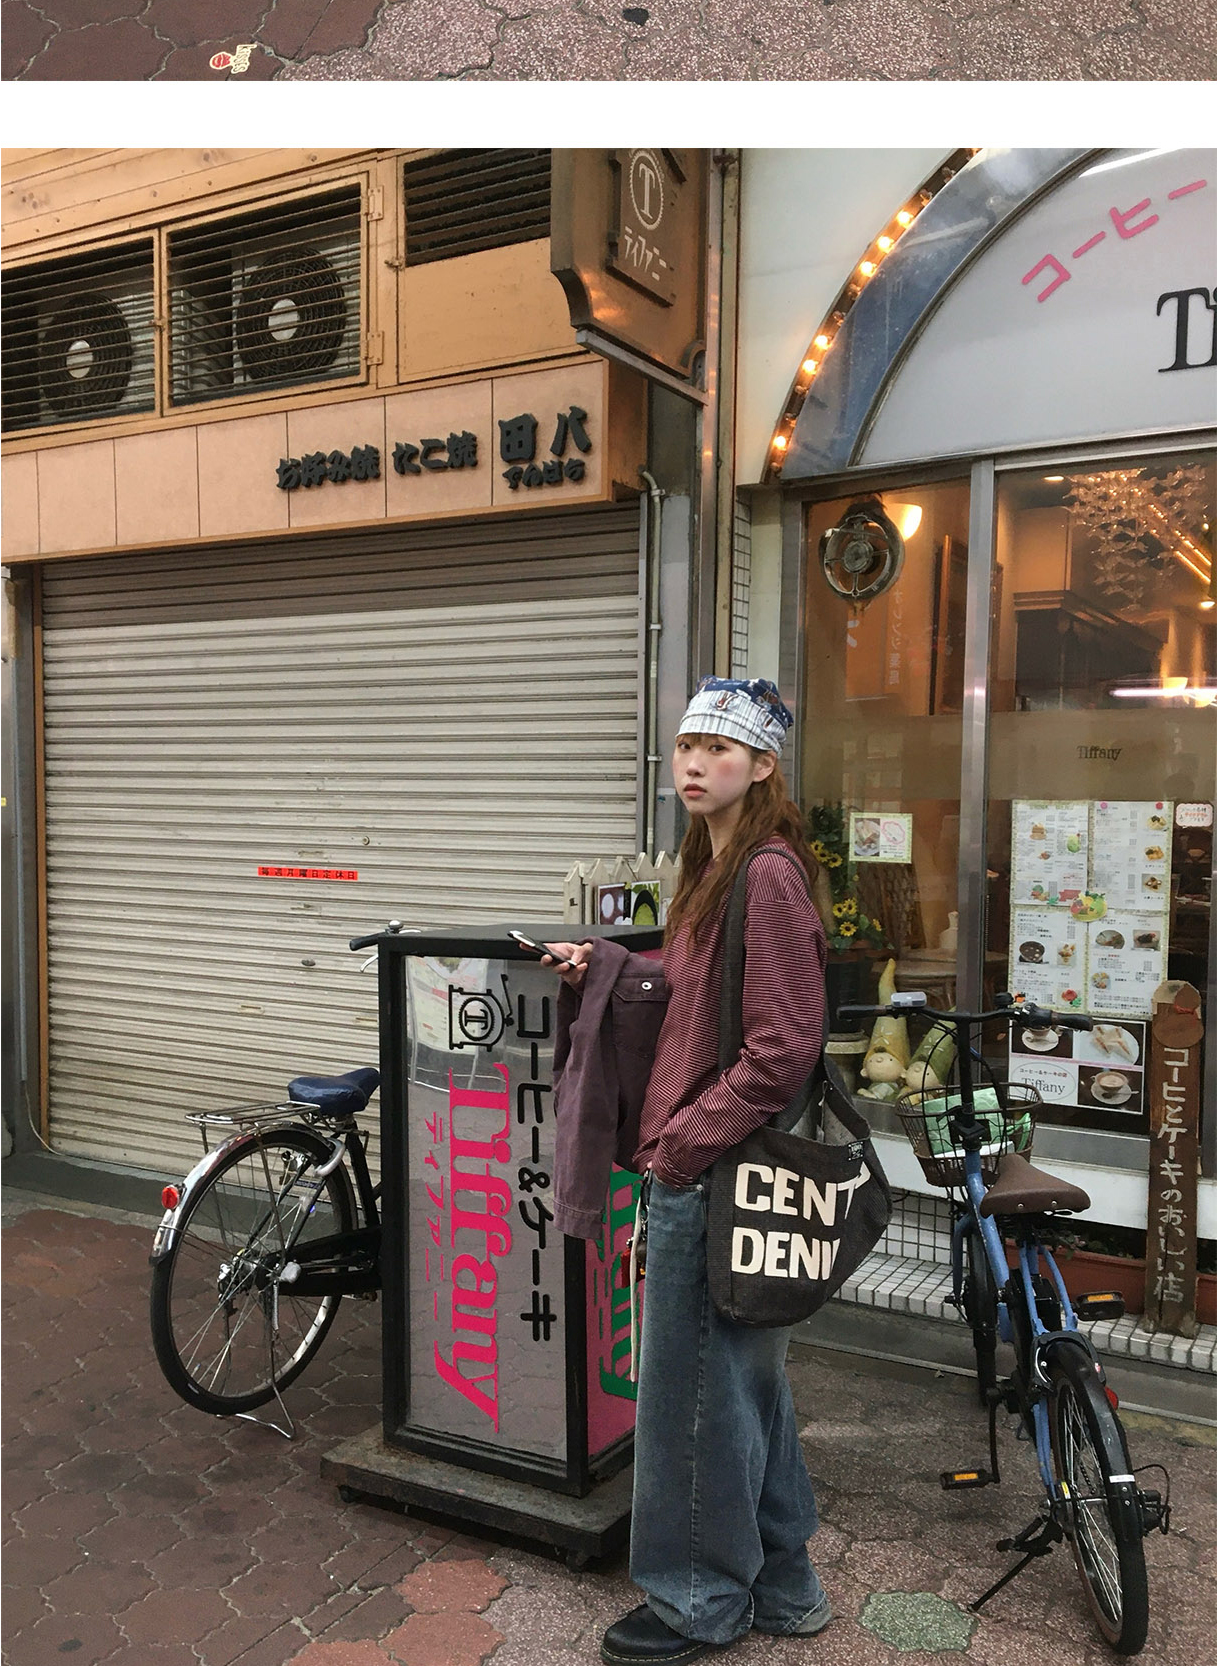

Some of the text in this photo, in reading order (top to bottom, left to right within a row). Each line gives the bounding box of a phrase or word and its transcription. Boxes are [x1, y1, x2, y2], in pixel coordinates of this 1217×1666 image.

[1077, 745, 1122, 761] Tiffany
[261, 867, 355, 880] 毎週月曜日定休日
[434, 1063, 512, 1433] Tiffany
